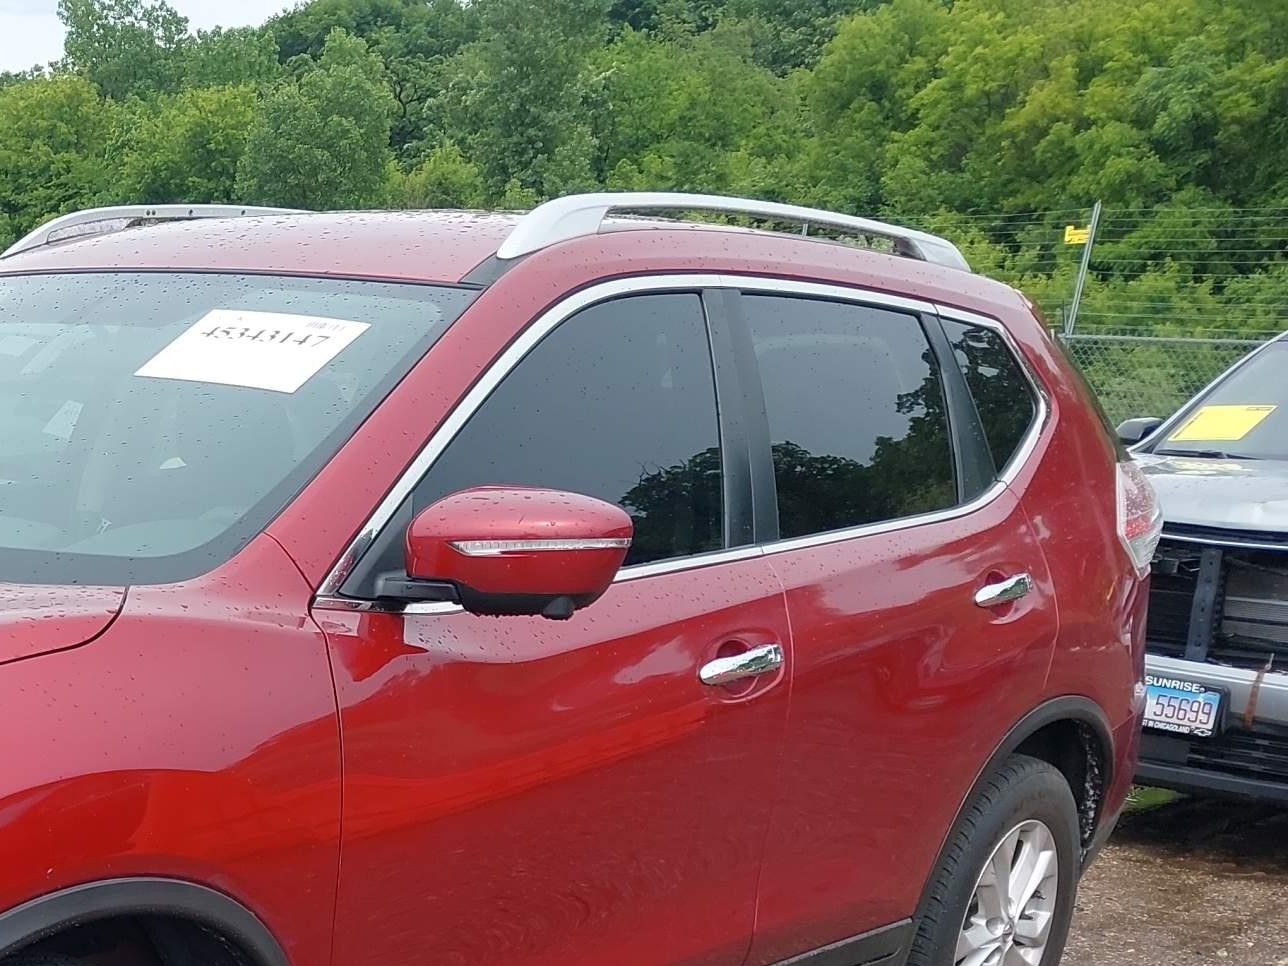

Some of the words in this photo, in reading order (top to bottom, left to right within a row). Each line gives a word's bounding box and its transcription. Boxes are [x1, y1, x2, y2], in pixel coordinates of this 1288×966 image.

[200, 325, 331, 348] 45343147
[1145, 676, 1201, 693] SUNRISE
[1153, 694, 1214, 725] 55699
